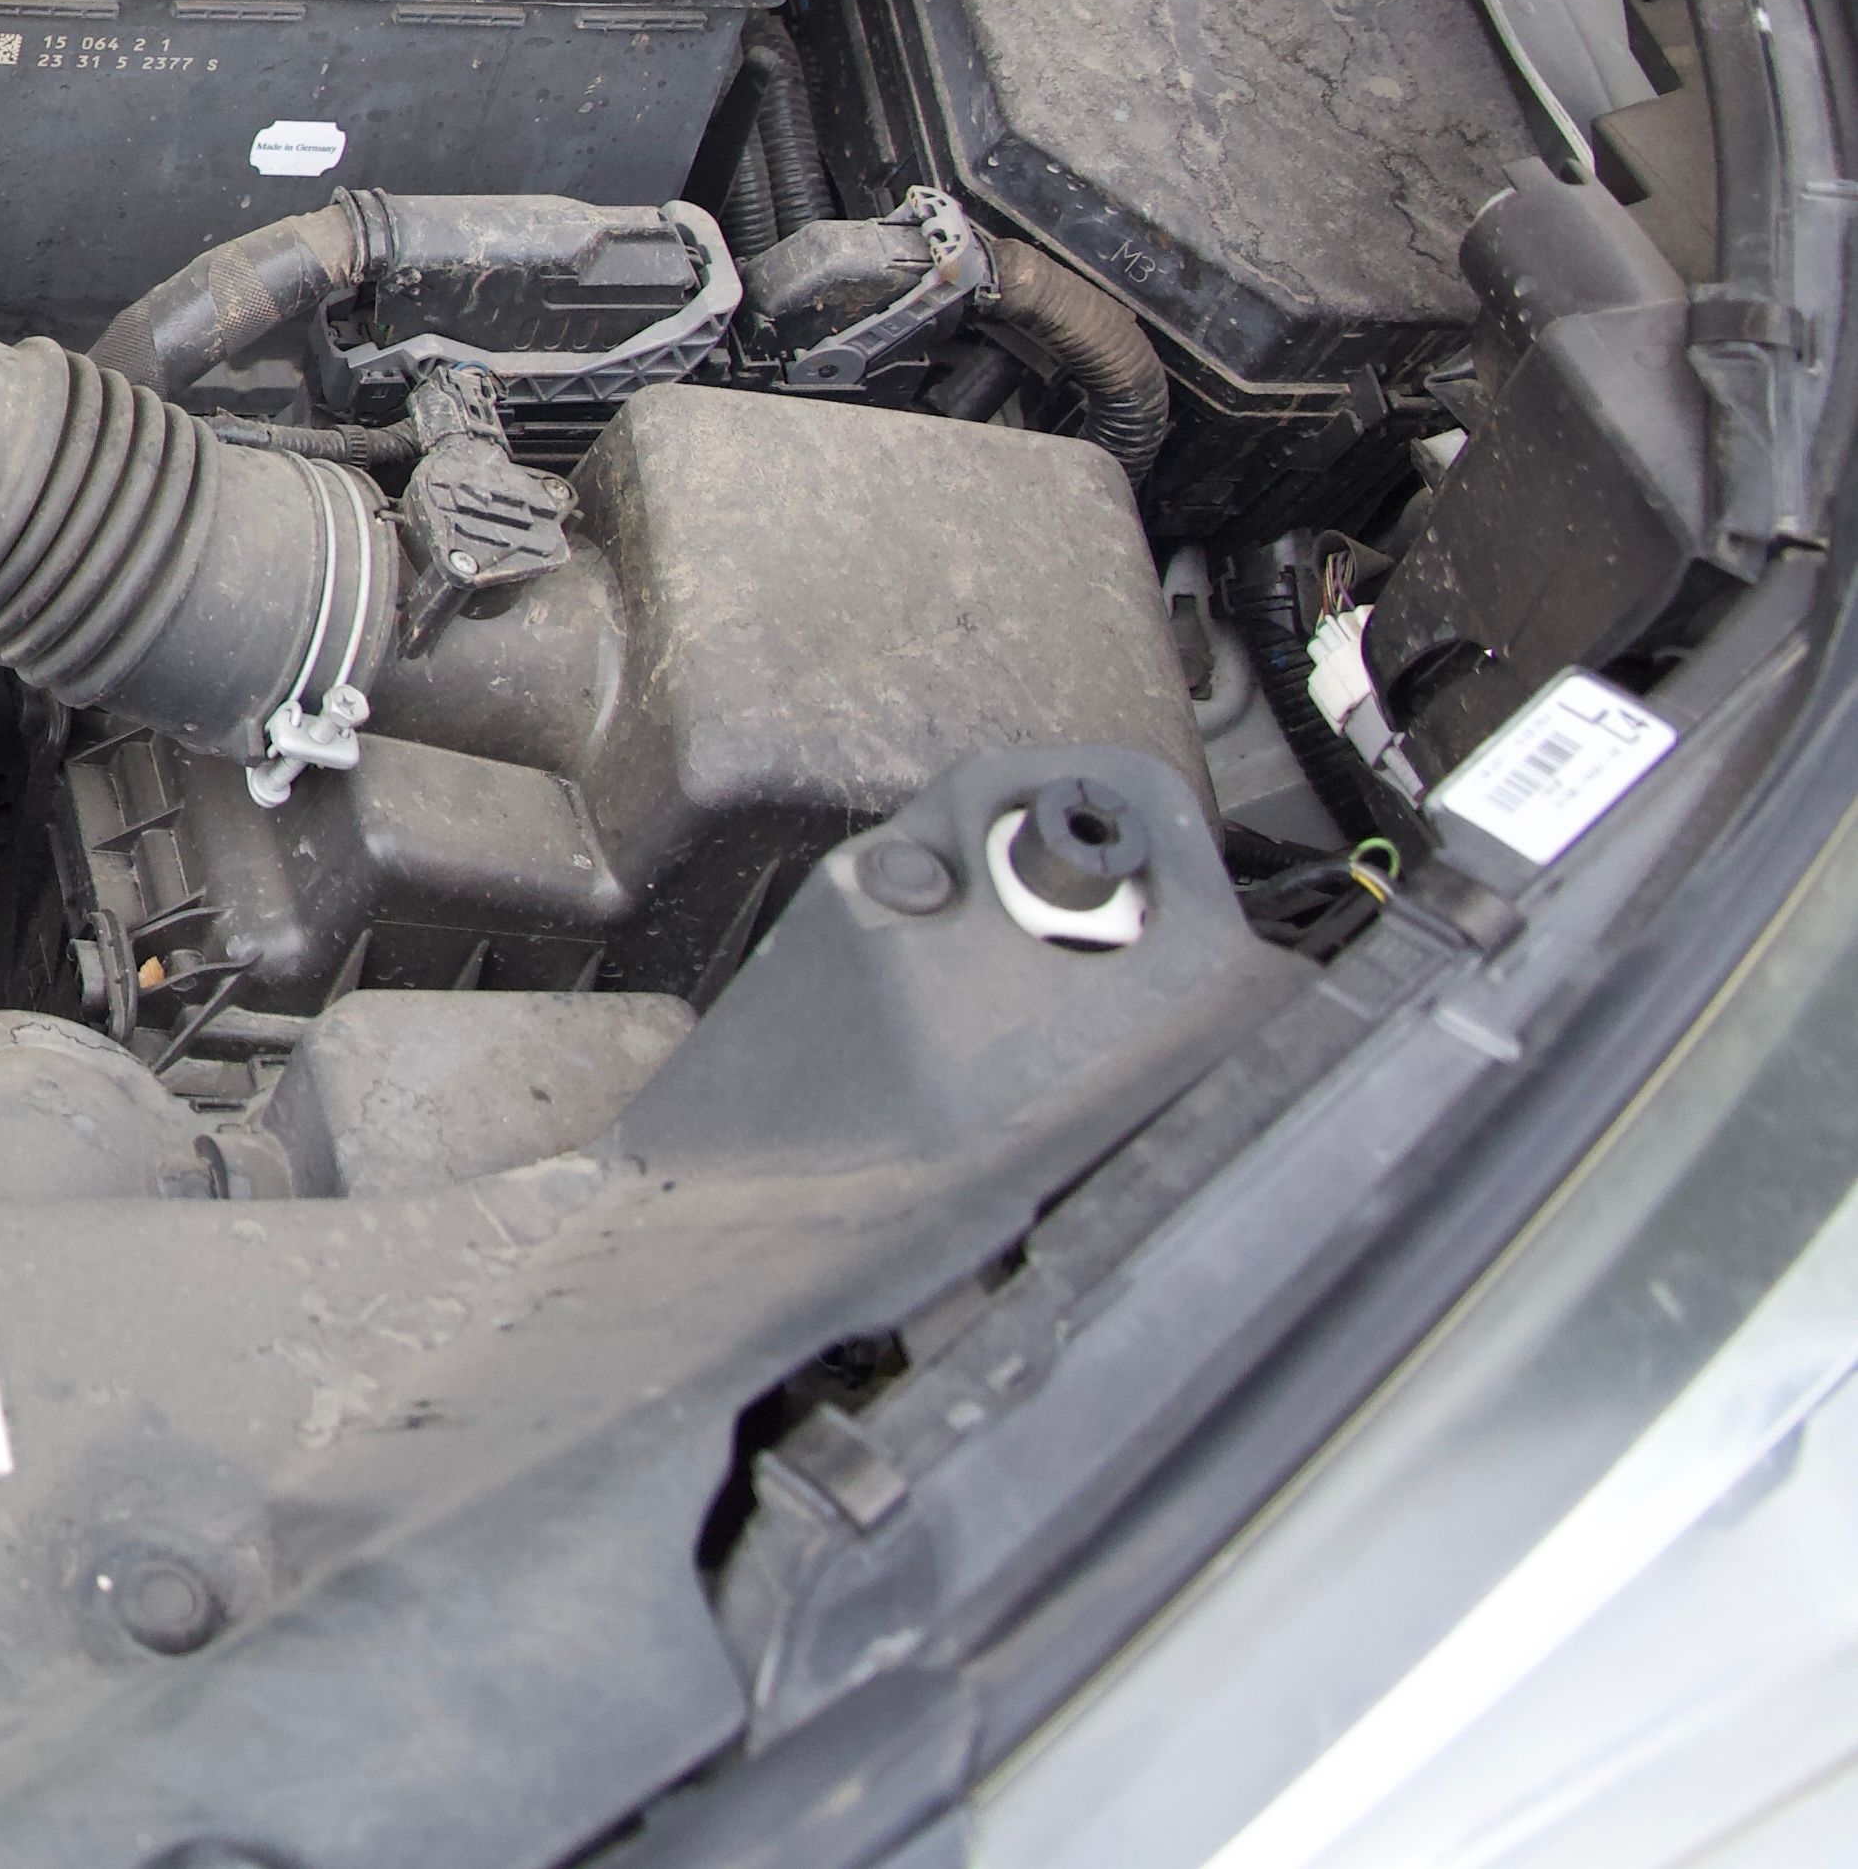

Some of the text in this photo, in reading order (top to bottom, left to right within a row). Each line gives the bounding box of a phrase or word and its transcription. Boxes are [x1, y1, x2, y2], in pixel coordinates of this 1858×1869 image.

[43, 35, 171, 52] 15 064 2 1
[38, 53, 63, 68] 23
[76, 55, 101, 69] 31
[116, 56, 128, 69] 5
[142, 57, 194, 71] 2377
[256, 142, 337, 154] Made in Germany
[1110, 239, 1156, 283] M3
[1558, 701, 1609, 725] L
